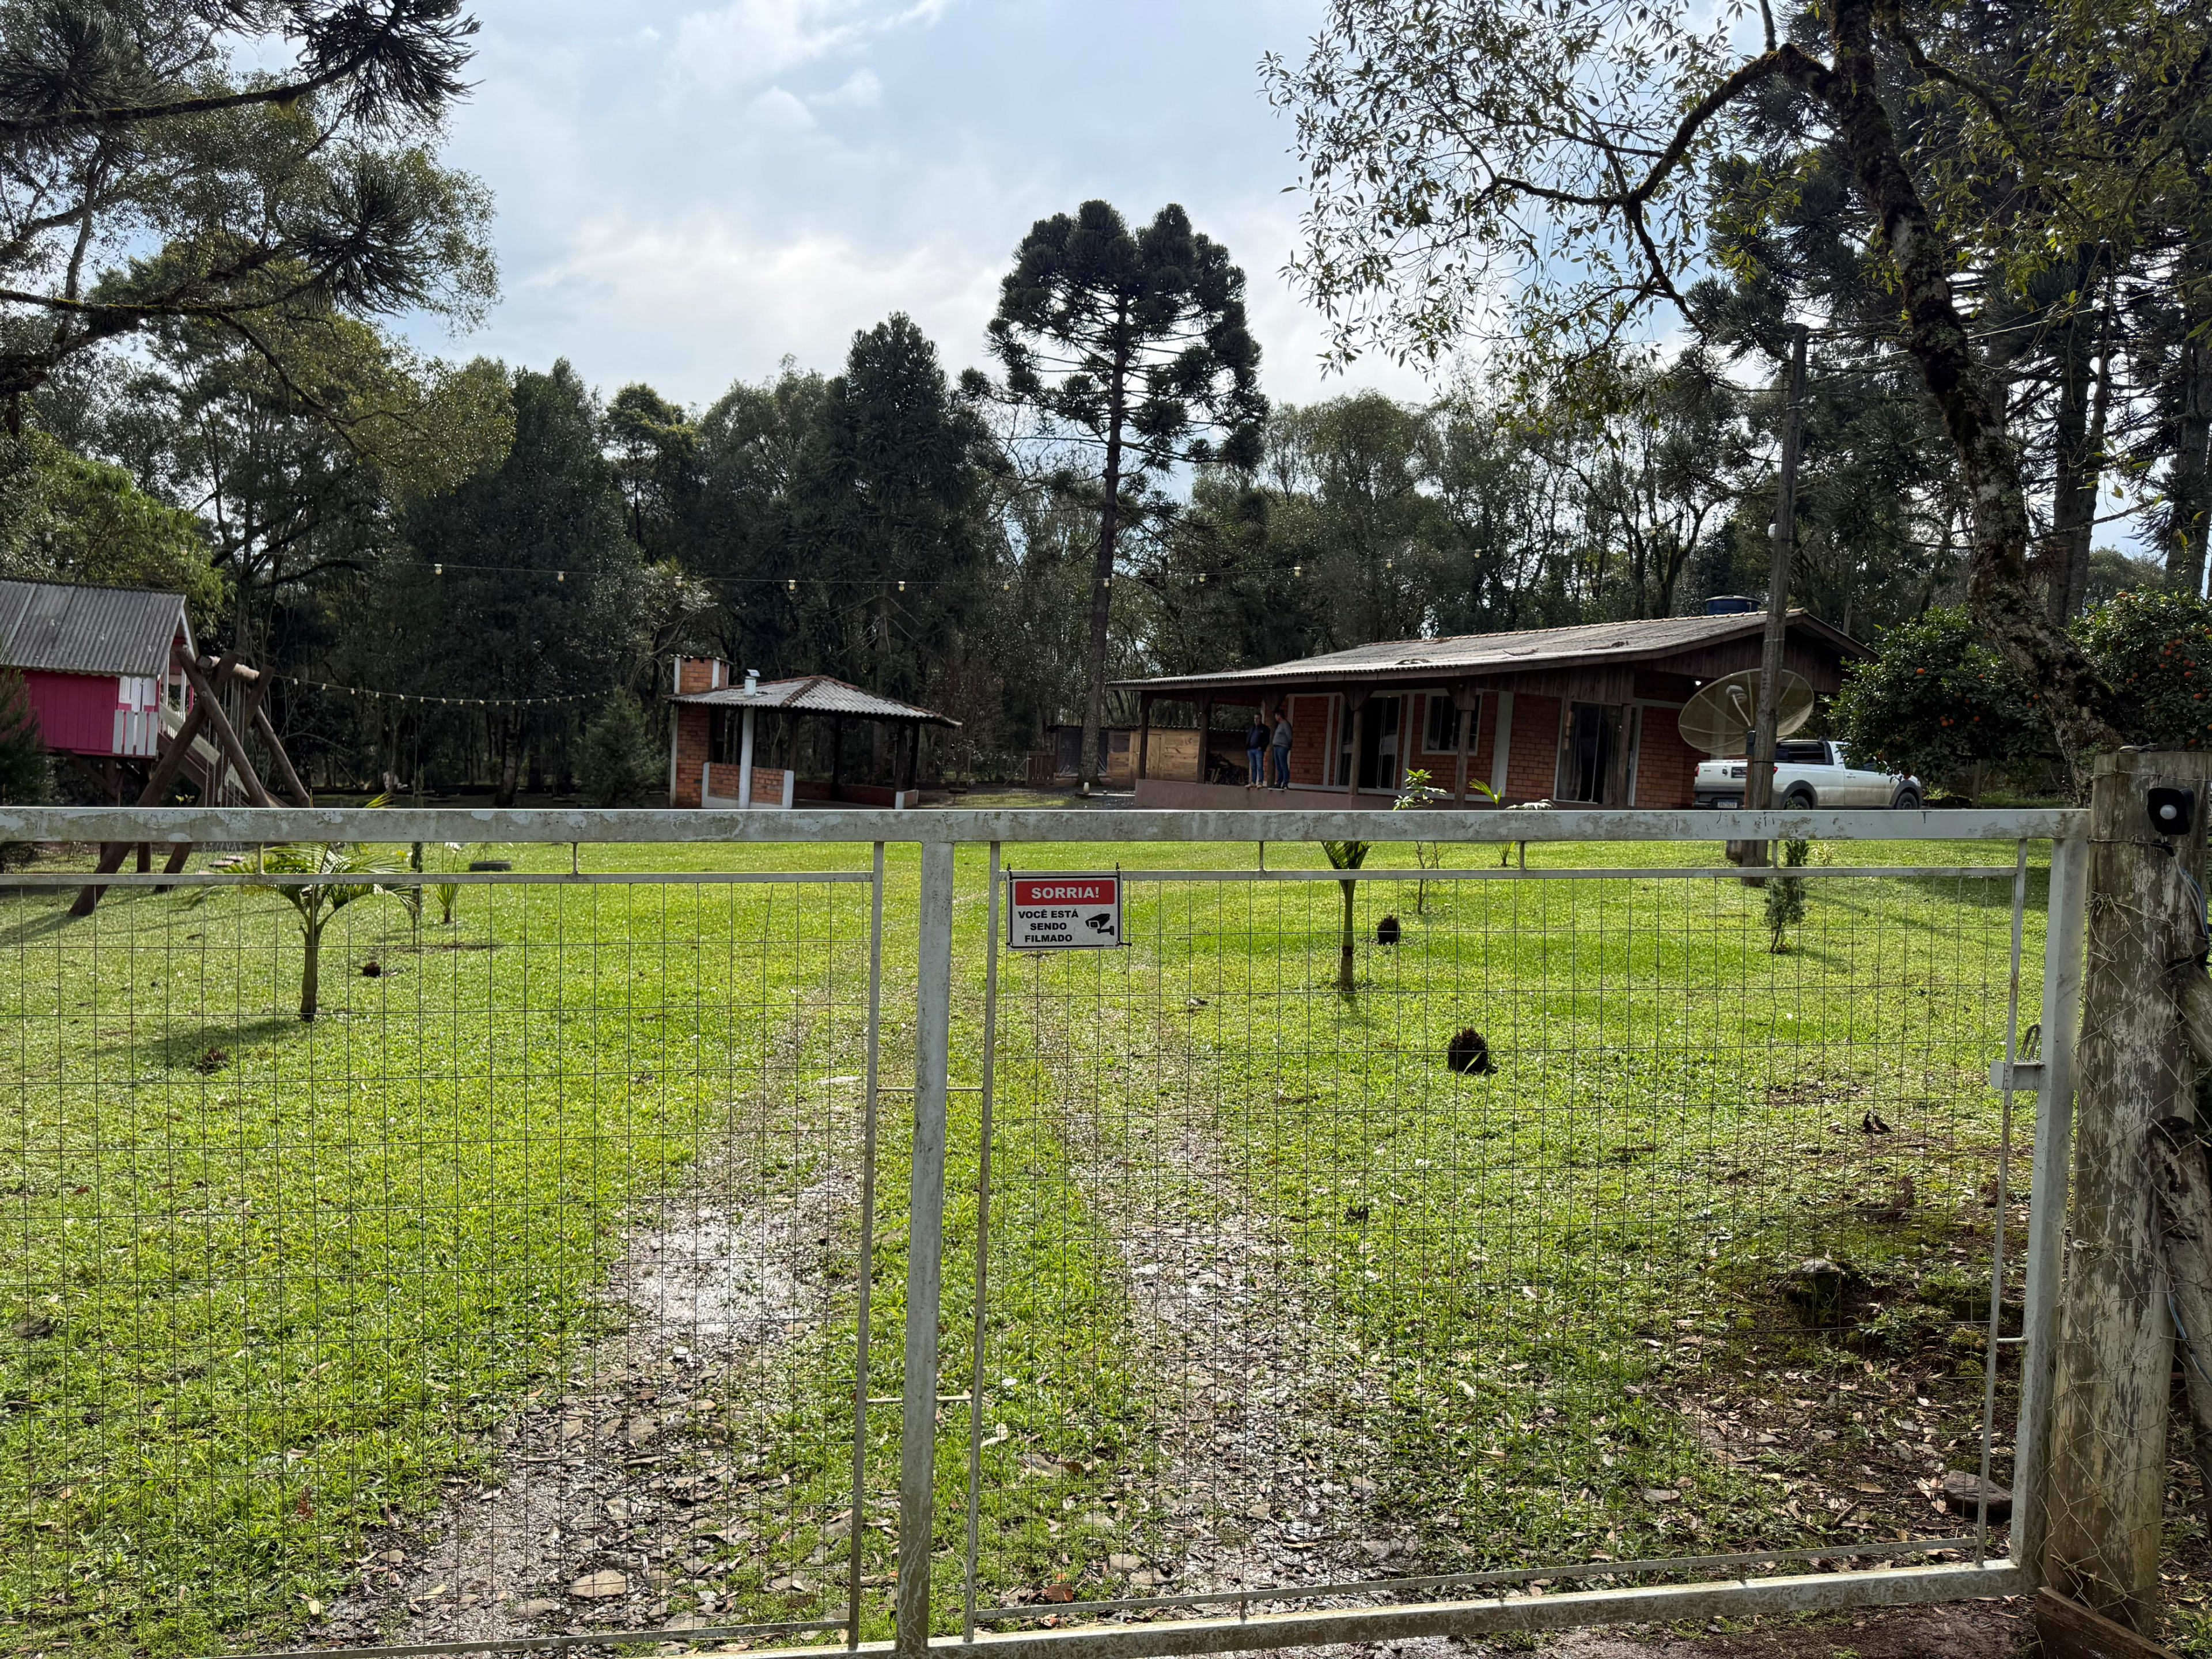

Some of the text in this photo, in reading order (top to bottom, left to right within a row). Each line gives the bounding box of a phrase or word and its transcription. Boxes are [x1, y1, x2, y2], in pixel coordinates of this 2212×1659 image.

[1031, 887, 1099, 899] SORRIA!
[1018, 908, 1079, 919] VOCÊ ESTÁ
[1030, 922, 1067, 931] SENDO
[1024, 934, 1073, 943] FILMADO
